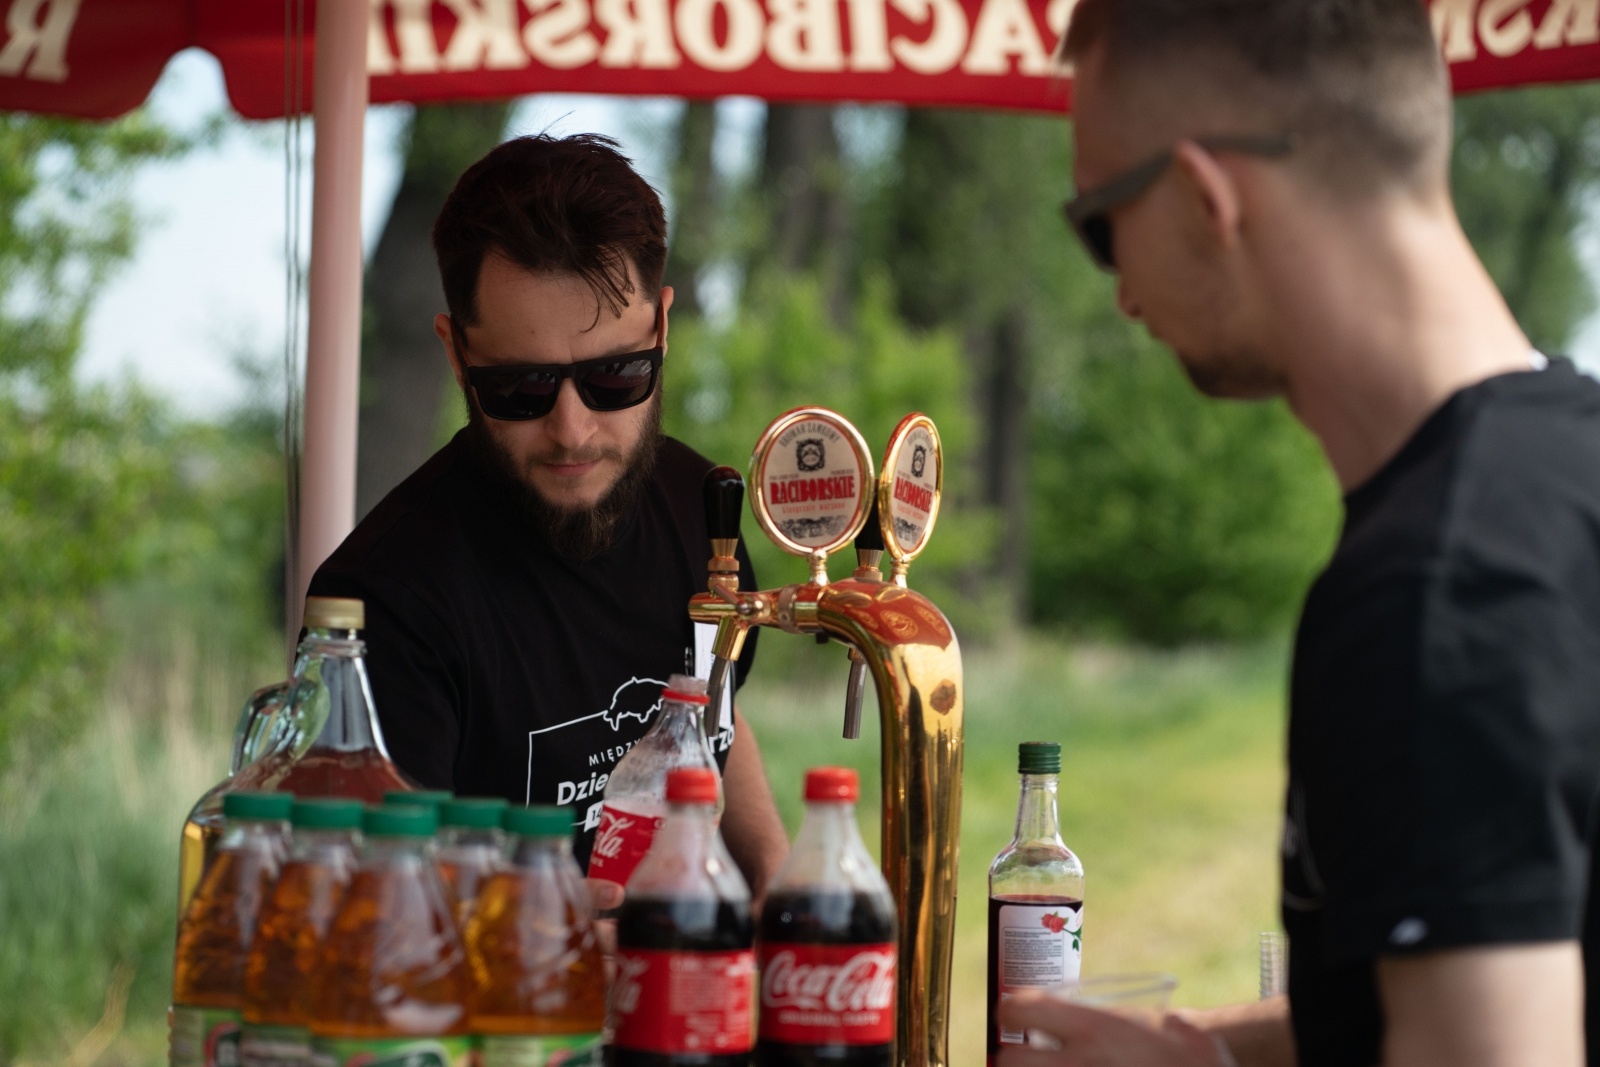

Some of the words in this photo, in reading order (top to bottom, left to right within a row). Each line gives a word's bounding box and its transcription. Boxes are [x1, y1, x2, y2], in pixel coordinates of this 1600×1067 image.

[770, 475, 855, 505] RACIBORSKIE
[588, 738, 640, 767] MIĘDZY
[557, 771, 608, 806] Dzie
